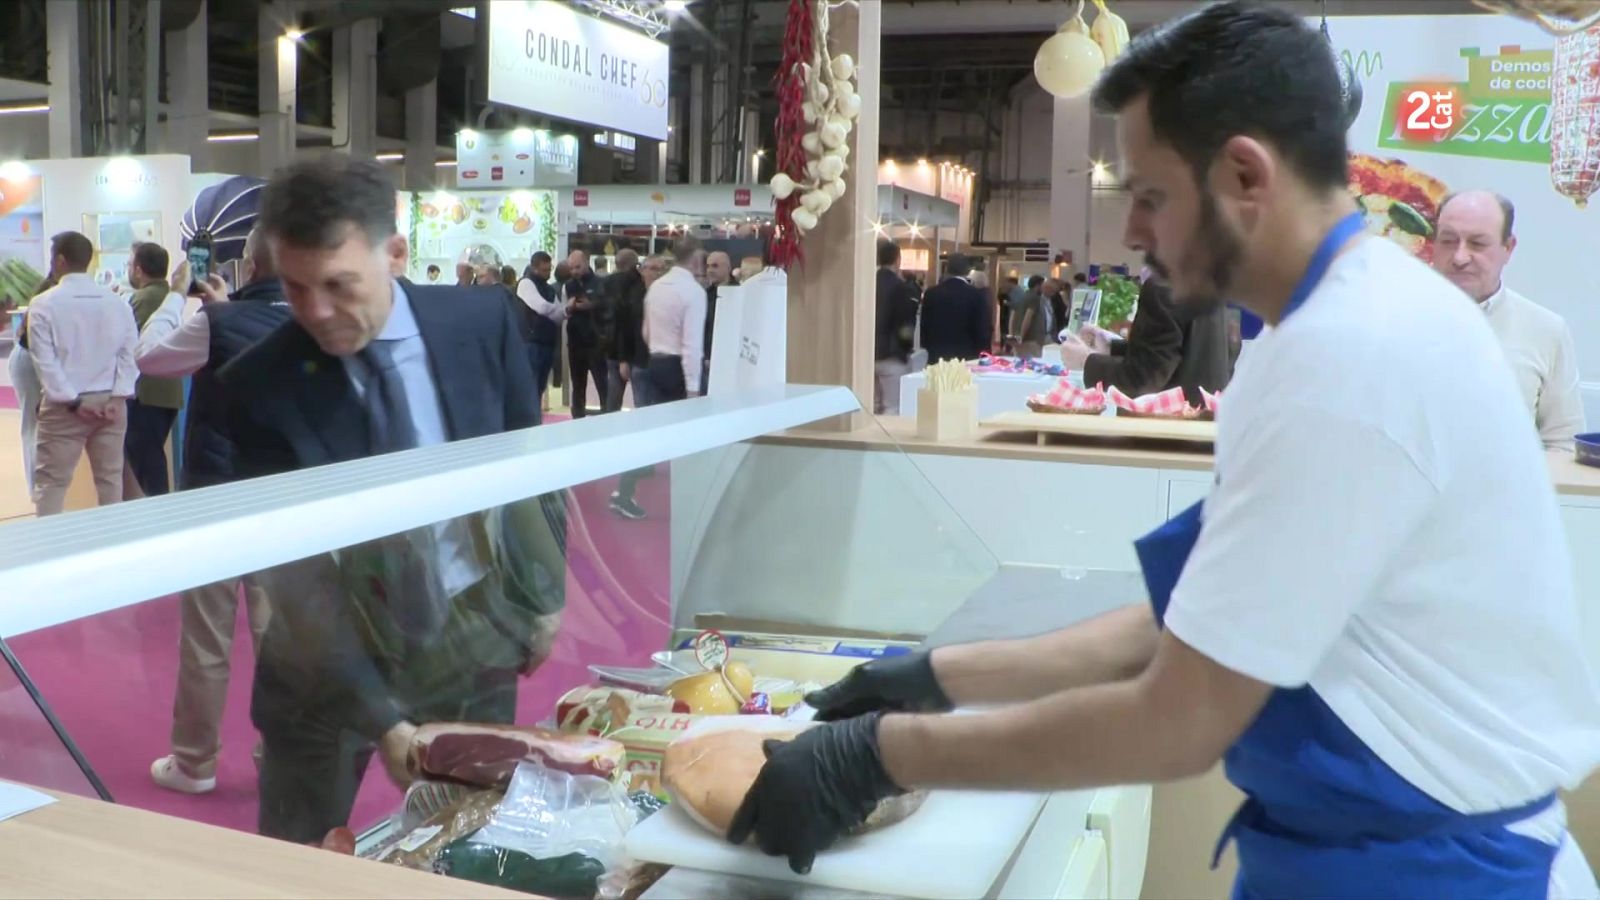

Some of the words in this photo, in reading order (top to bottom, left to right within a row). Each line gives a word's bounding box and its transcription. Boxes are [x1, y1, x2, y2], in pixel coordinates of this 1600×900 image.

[525, 28, 591, 77] CONDAL
[600, 54, 637, 89] CHEF
[1490, 59, 1551, 73] Demos
[1489, 77, 1511, 90] de
